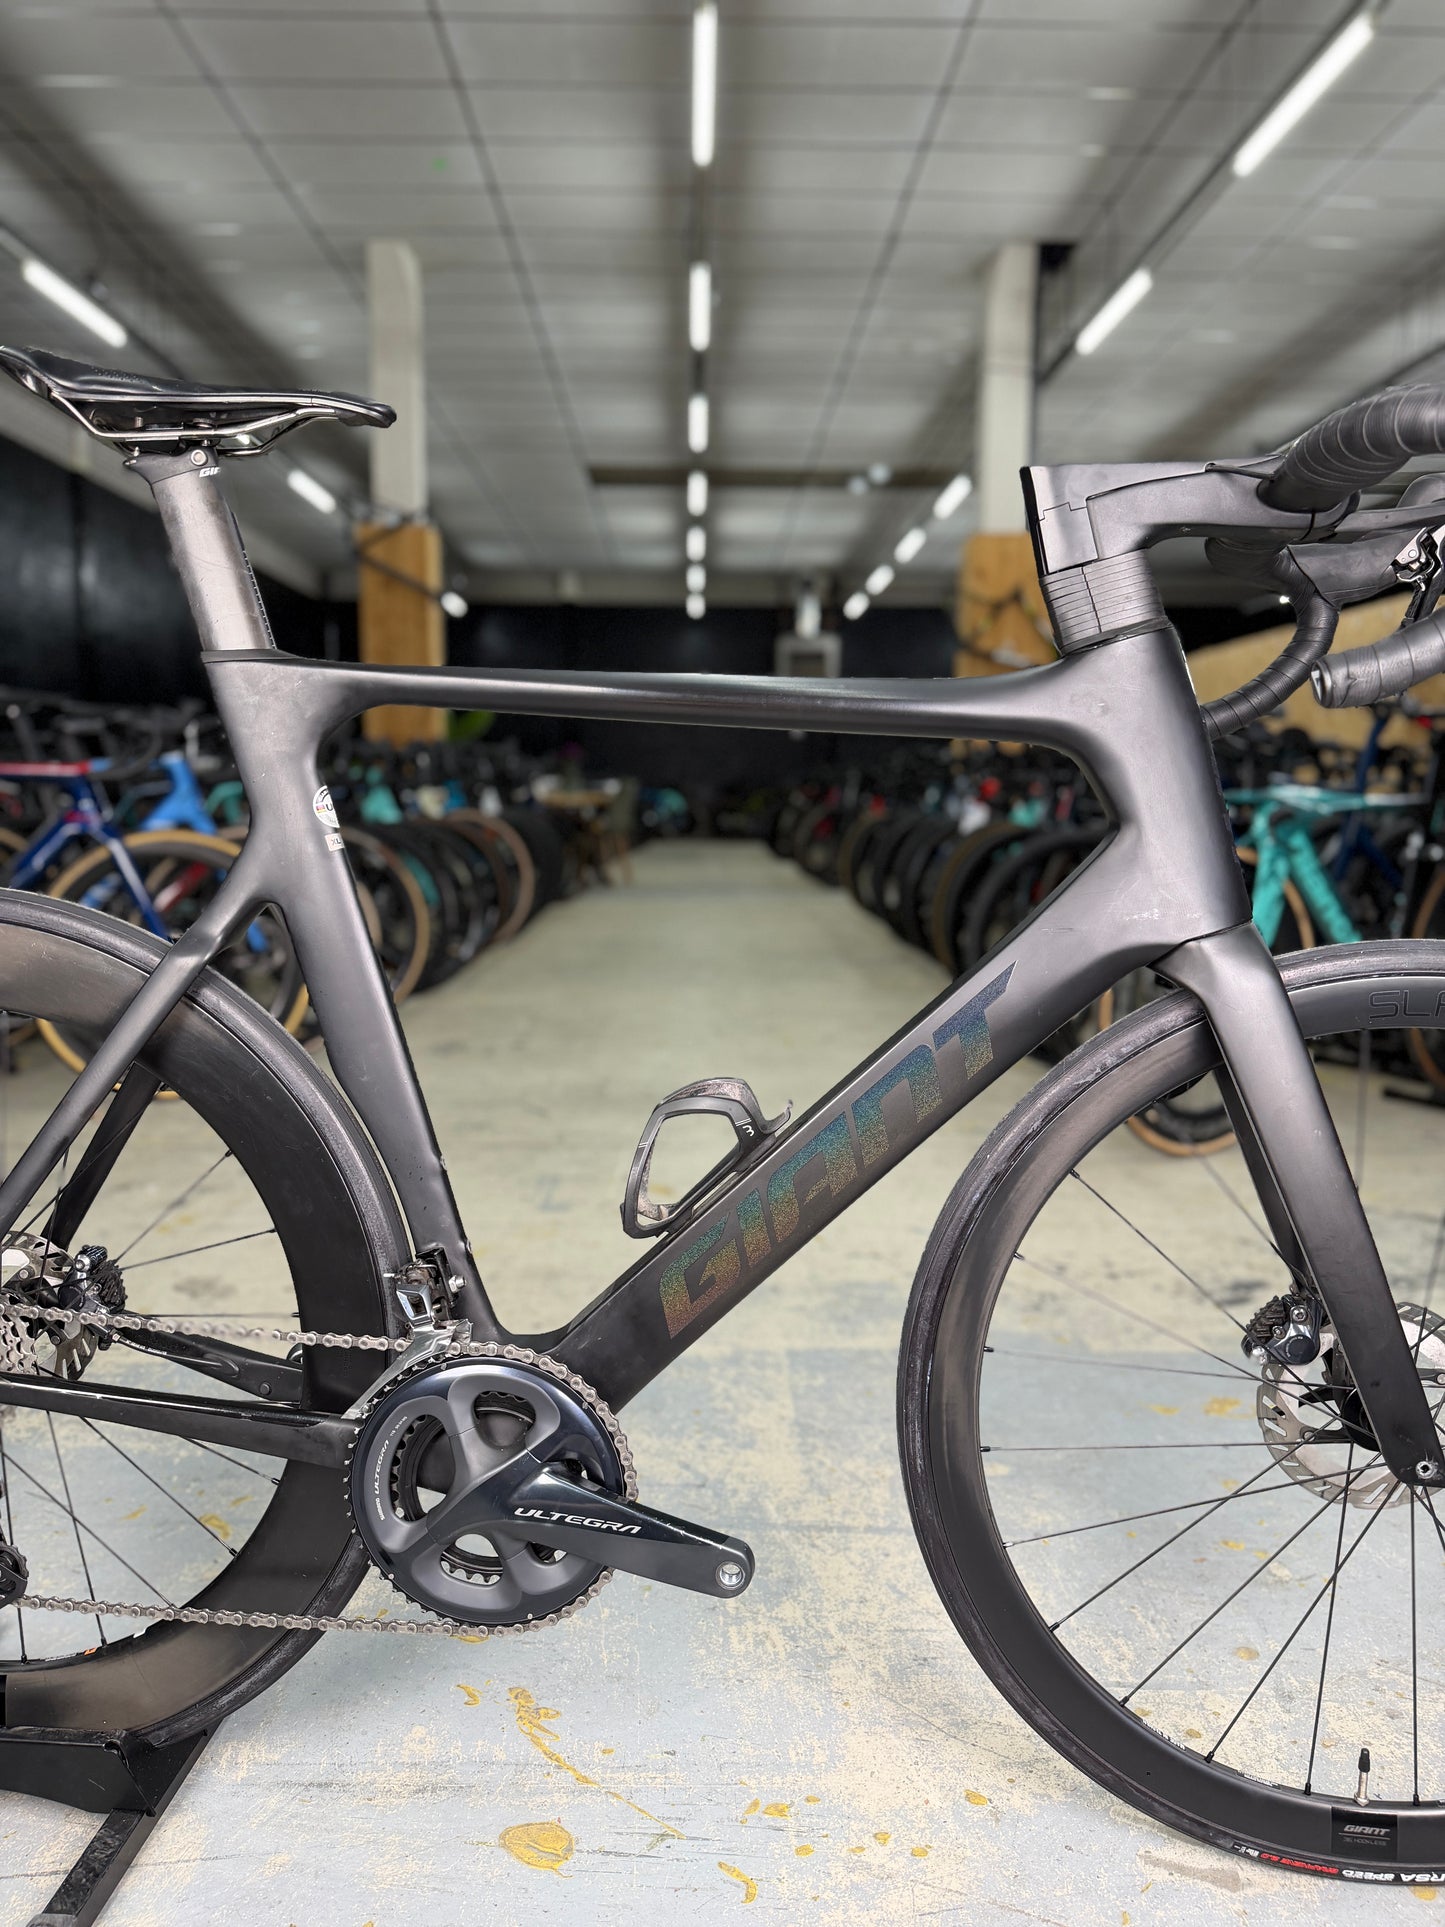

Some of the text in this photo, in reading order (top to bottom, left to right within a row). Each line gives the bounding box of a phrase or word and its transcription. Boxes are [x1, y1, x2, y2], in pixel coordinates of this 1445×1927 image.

[658, 959, 1018, 1340] GIANT
[374, 1439, 390, 1495] ULTEGRA
[513, 1507, 642, 1534] ULTEGRA
[1343, 1824, 1391, 1836] GIANT
[1342, 1869, 1396, 1882] SPEED
